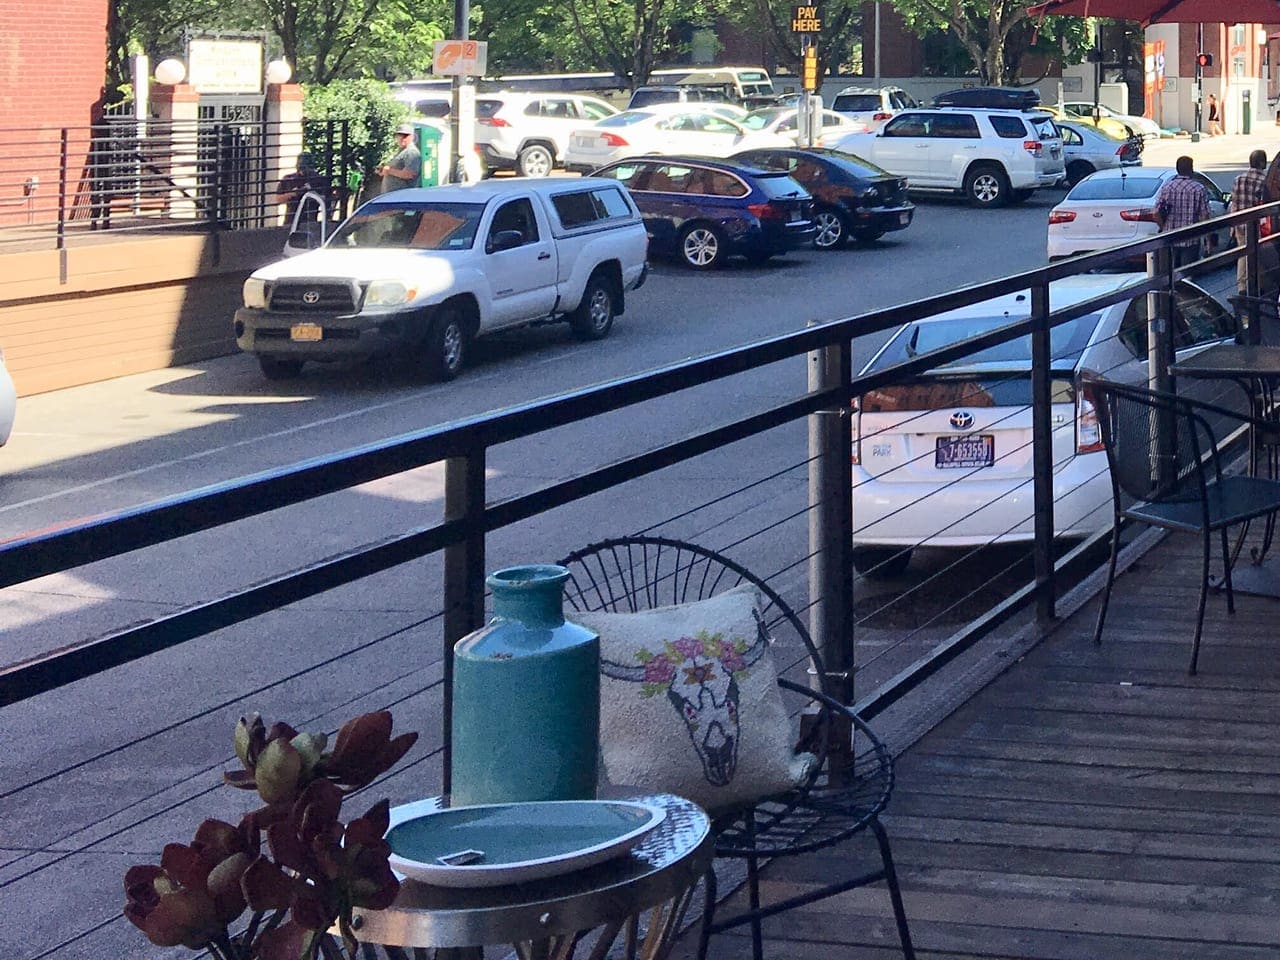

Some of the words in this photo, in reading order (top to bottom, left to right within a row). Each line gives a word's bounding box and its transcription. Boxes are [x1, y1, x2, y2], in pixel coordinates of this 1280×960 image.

[797, 6, 818, 19] PAY
[792, 19, 821, 32] HERE
[466, 43, 474, 56] 2
